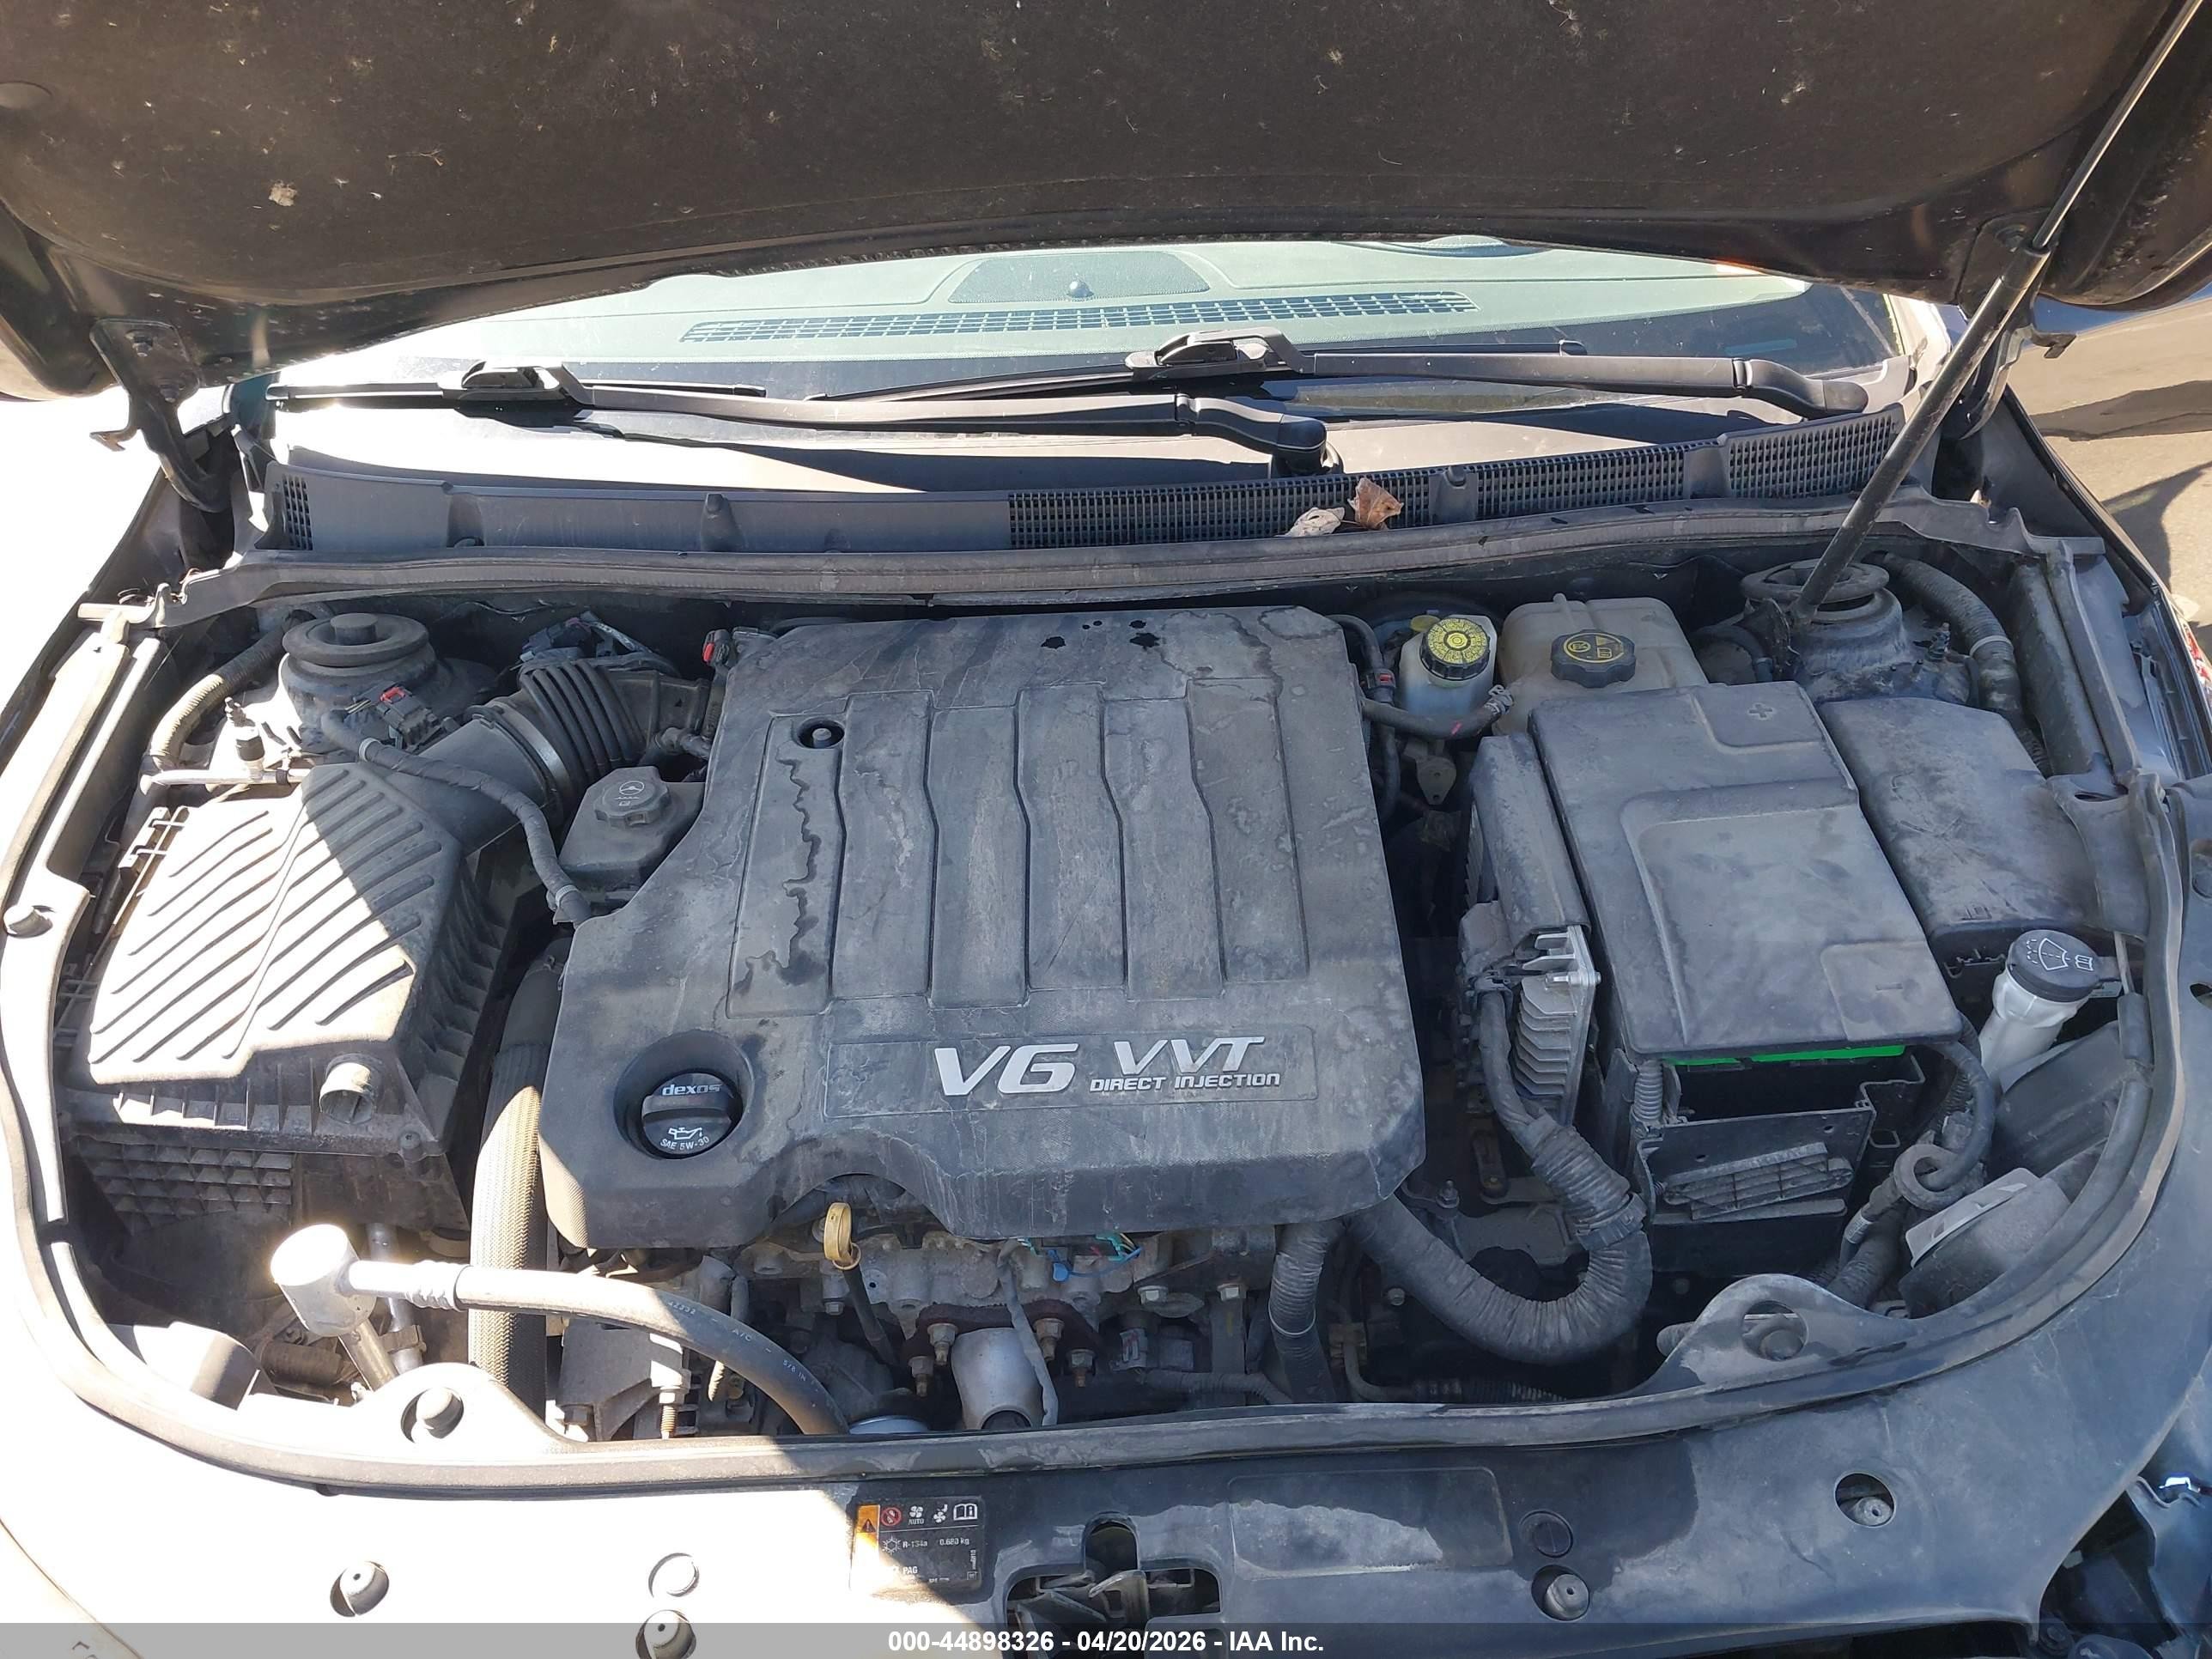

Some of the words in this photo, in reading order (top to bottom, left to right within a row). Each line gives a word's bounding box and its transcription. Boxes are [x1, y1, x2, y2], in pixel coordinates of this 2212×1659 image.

[934, 1042, 1079, 1097] V6
[1113, 1036, 1266, 1075] VVT
[1089, 1075, 1166, 1092] DIRECT
[1174, 1073, 1280, 1090] INJECTION
[662, 1084, 722, 1097] dexos
[659, 1139, 677, 1151] SAE
[679, 1136, 710, 1151] 5W-30
[732, 1328, 751, 1341] A/C
[902, 1565, 918, 1575] PAG
